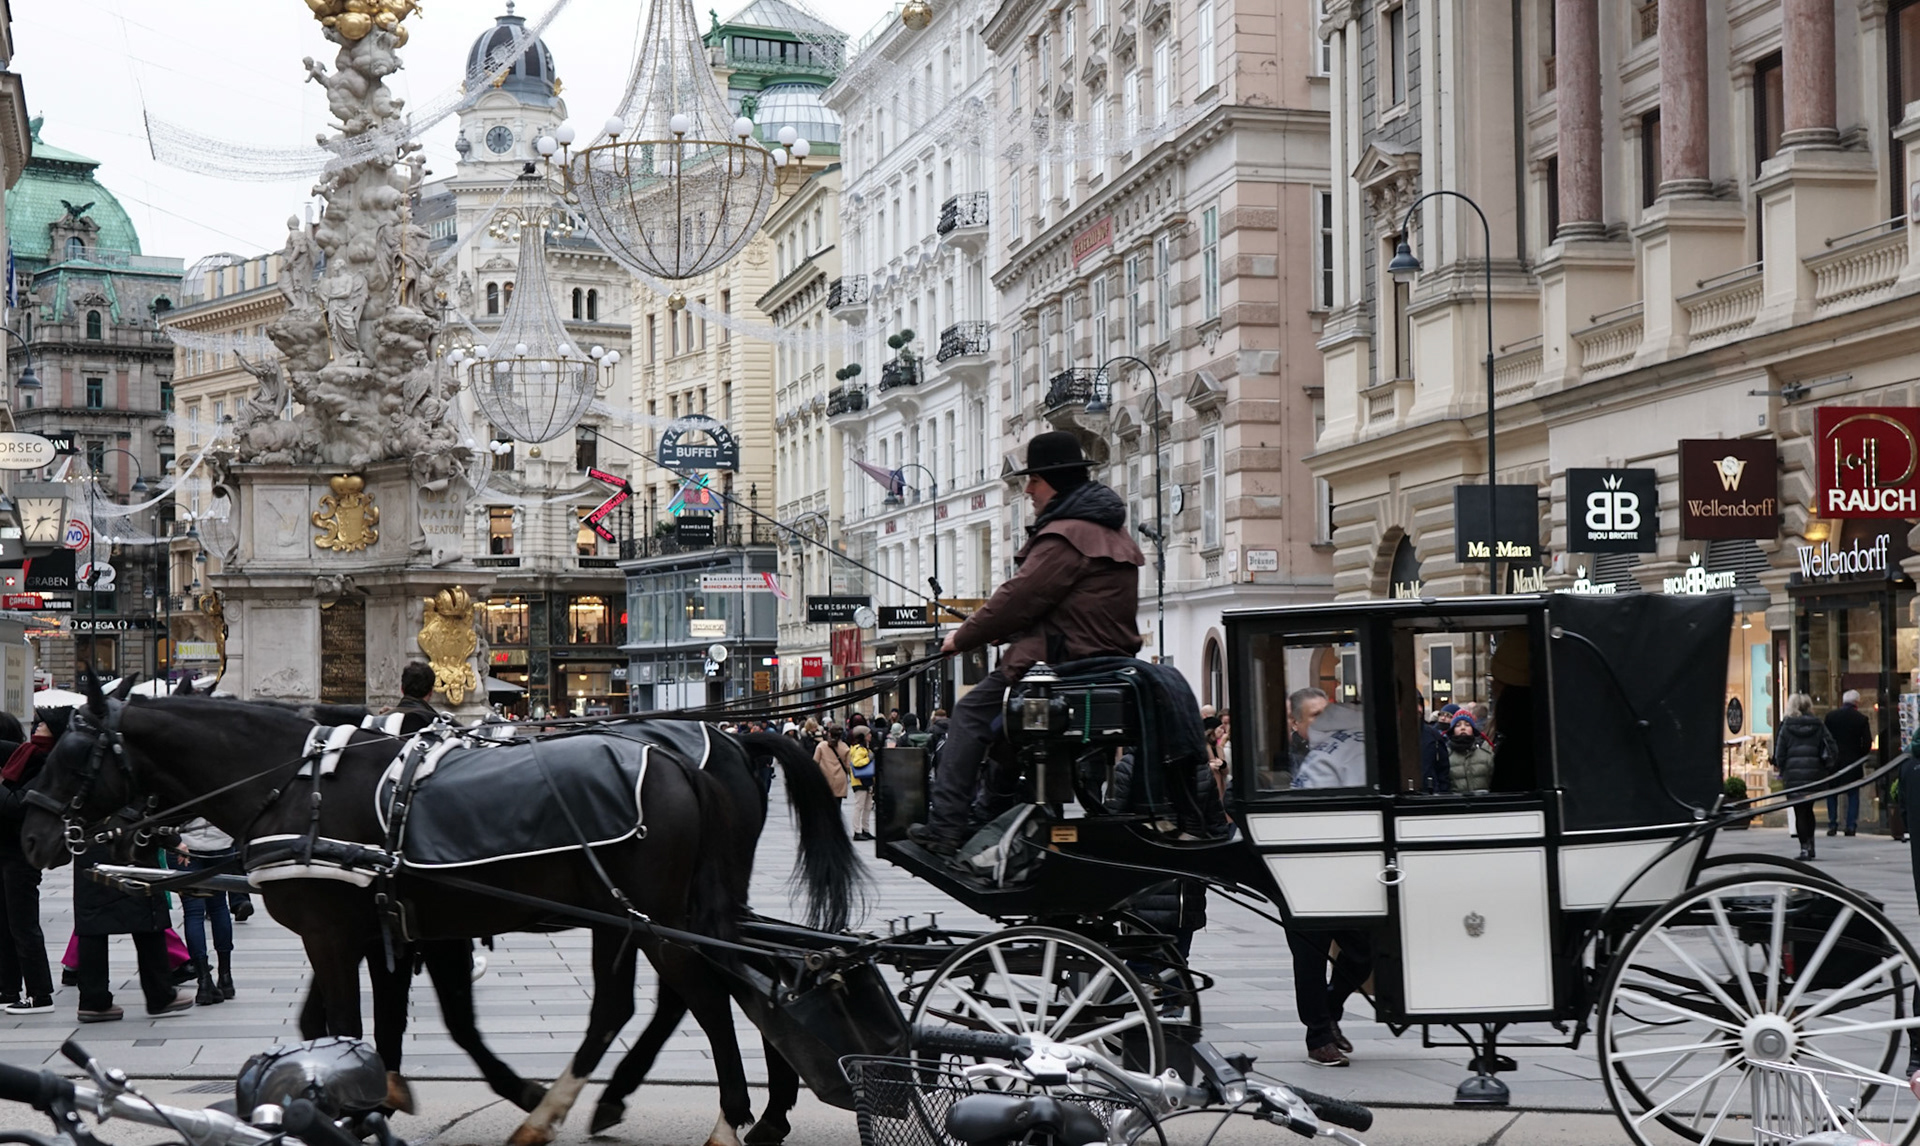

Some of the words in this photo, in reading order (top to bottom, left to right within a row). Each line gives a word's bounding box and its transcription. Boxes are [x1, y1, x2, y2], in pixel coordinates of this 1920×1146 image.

[676, 447, 719, 458] BUFFET
[1828, 489, 1917, 511] RAUCH
[1688, 498, 1775, 517] Wellendorff
[1588, 532, 1608, 541] BIJOU
[1609, 532, 1639, 541] BRIGITTE
[1467, 541, 1532, 558] MaMara
[1797, 533, 1890, 578] Wellendorff
[27, 576, 69, 587] GRABEN
[9, 597, 35, 607] CAMPER
[896, 609, 918, 619] IWC
[803, 660, 821, 668] högl
